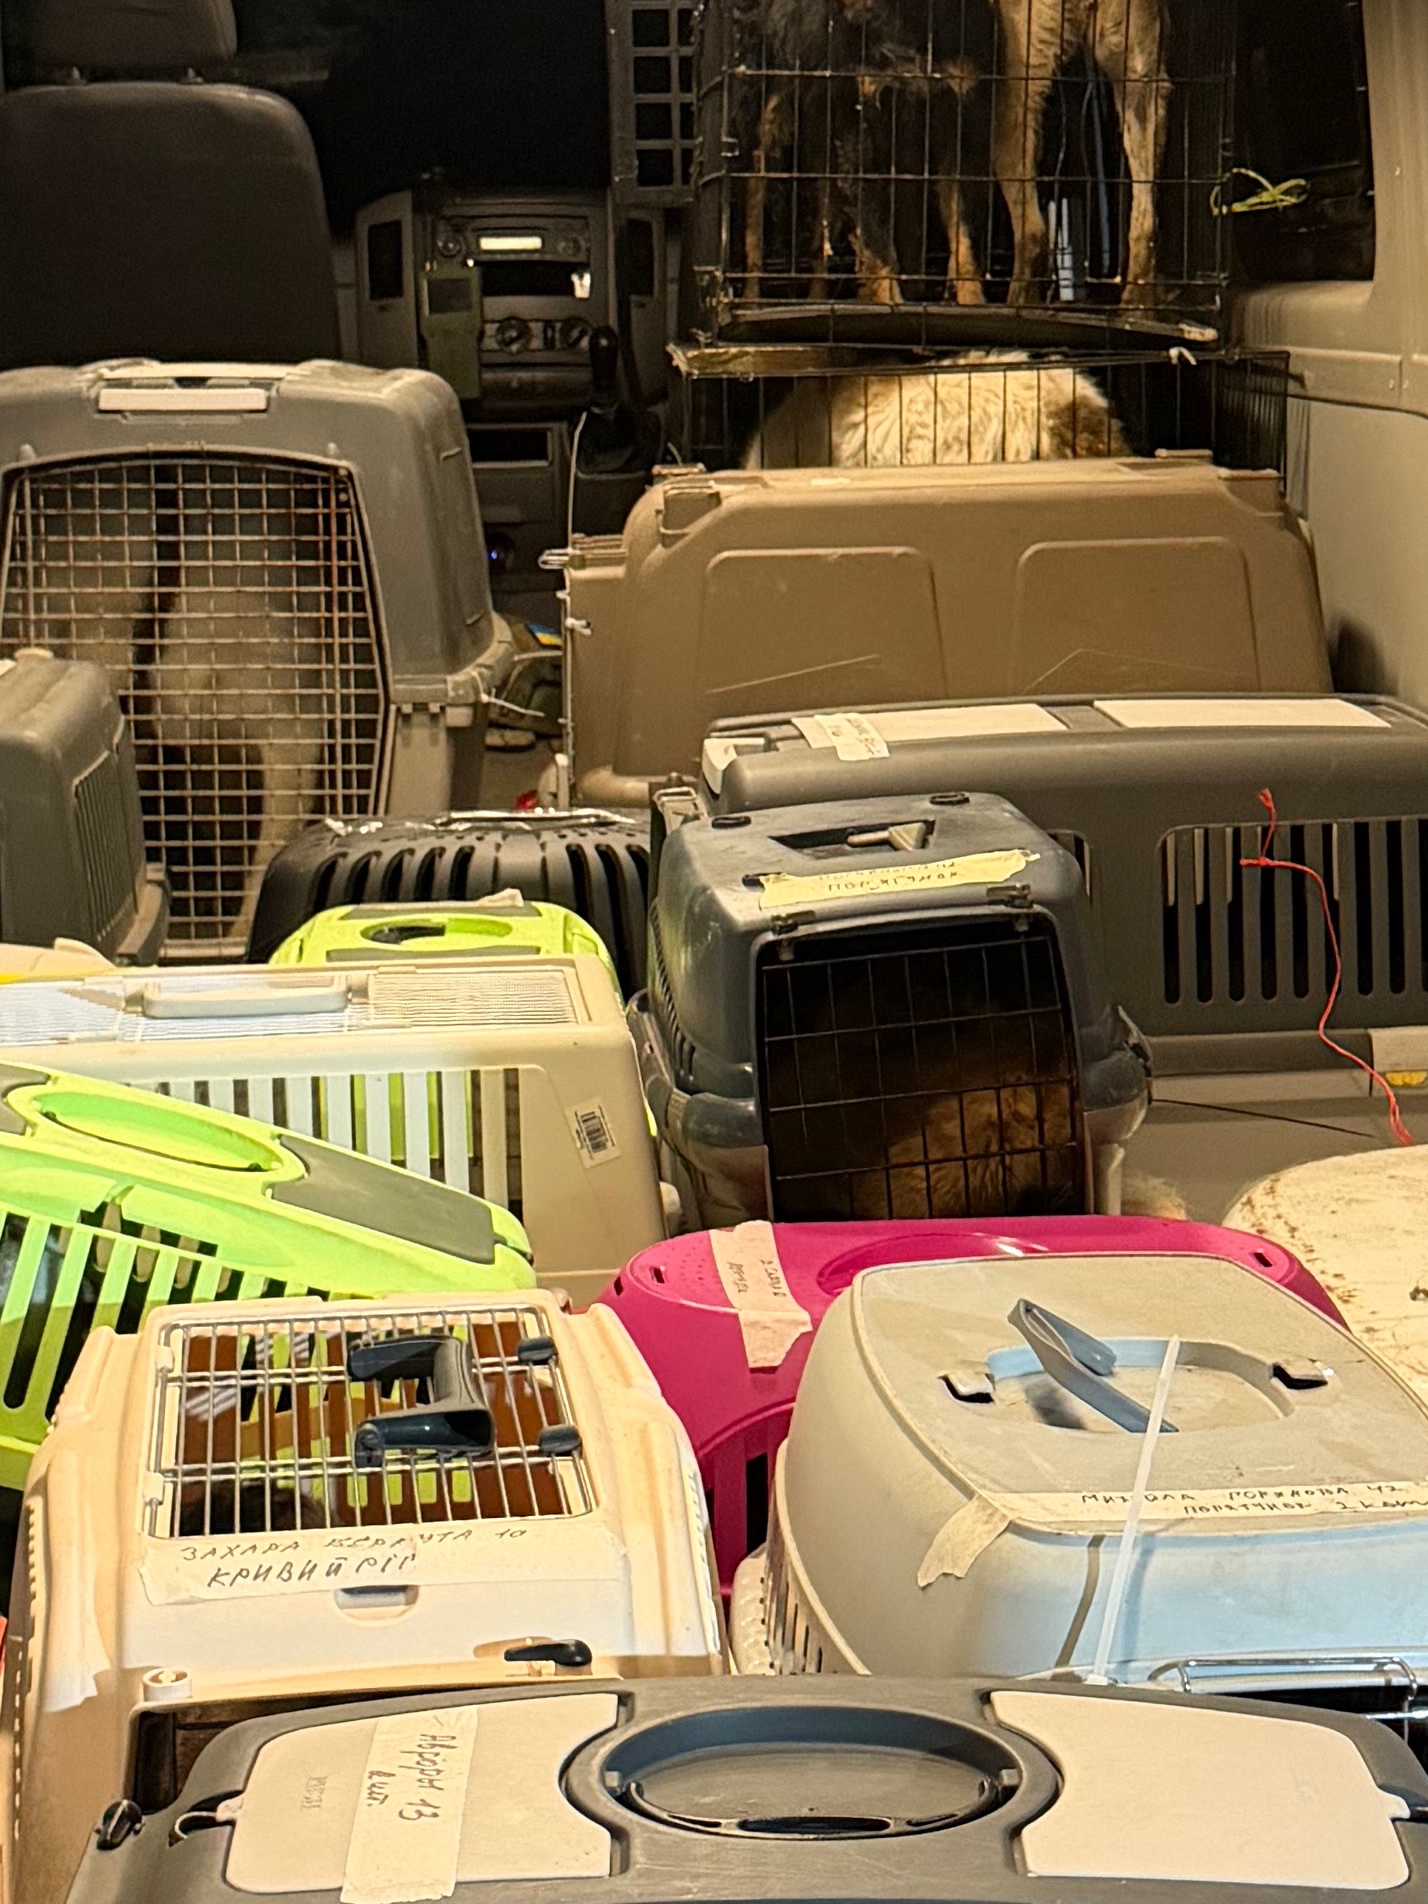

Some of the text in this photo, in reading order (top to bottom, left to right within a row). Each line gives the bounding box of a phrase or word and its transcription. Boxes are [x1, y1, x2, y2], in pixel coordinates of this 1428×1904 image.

[180, 1540, 300, 1560] ЗАХАРА
[206, 1556, 348, 1587] КРИВИЙ
[397, 1798, 442, 1822] 13
